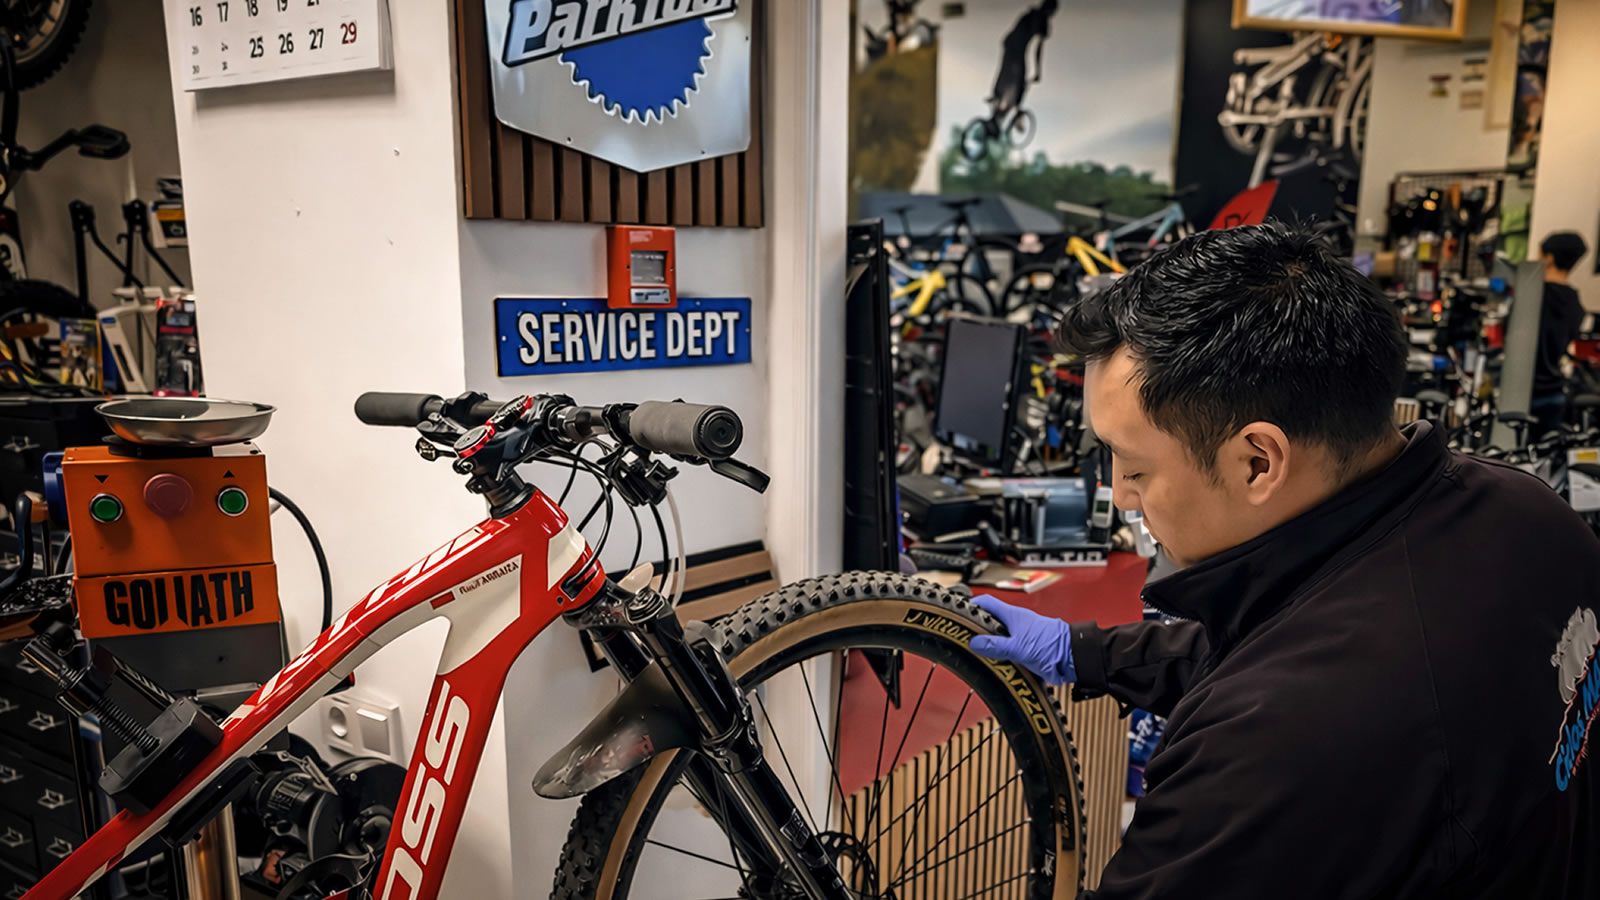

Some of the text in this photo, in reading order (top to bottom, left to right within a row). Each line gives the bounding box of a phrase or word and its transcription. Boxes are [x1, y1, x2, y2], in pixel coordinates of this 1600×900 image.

[190, 7, 203, 27] 16
[217, 2, 229, 22] 17
[246, 0, 259, 17] 18
[250, 37, 264, 58] 25
[278, 33, 294, 54] 26
[309, 28, 324, 50] 27
[340, 22, 357, 44] 29
[518, 311, 740, 364] SERVICE DEPT
